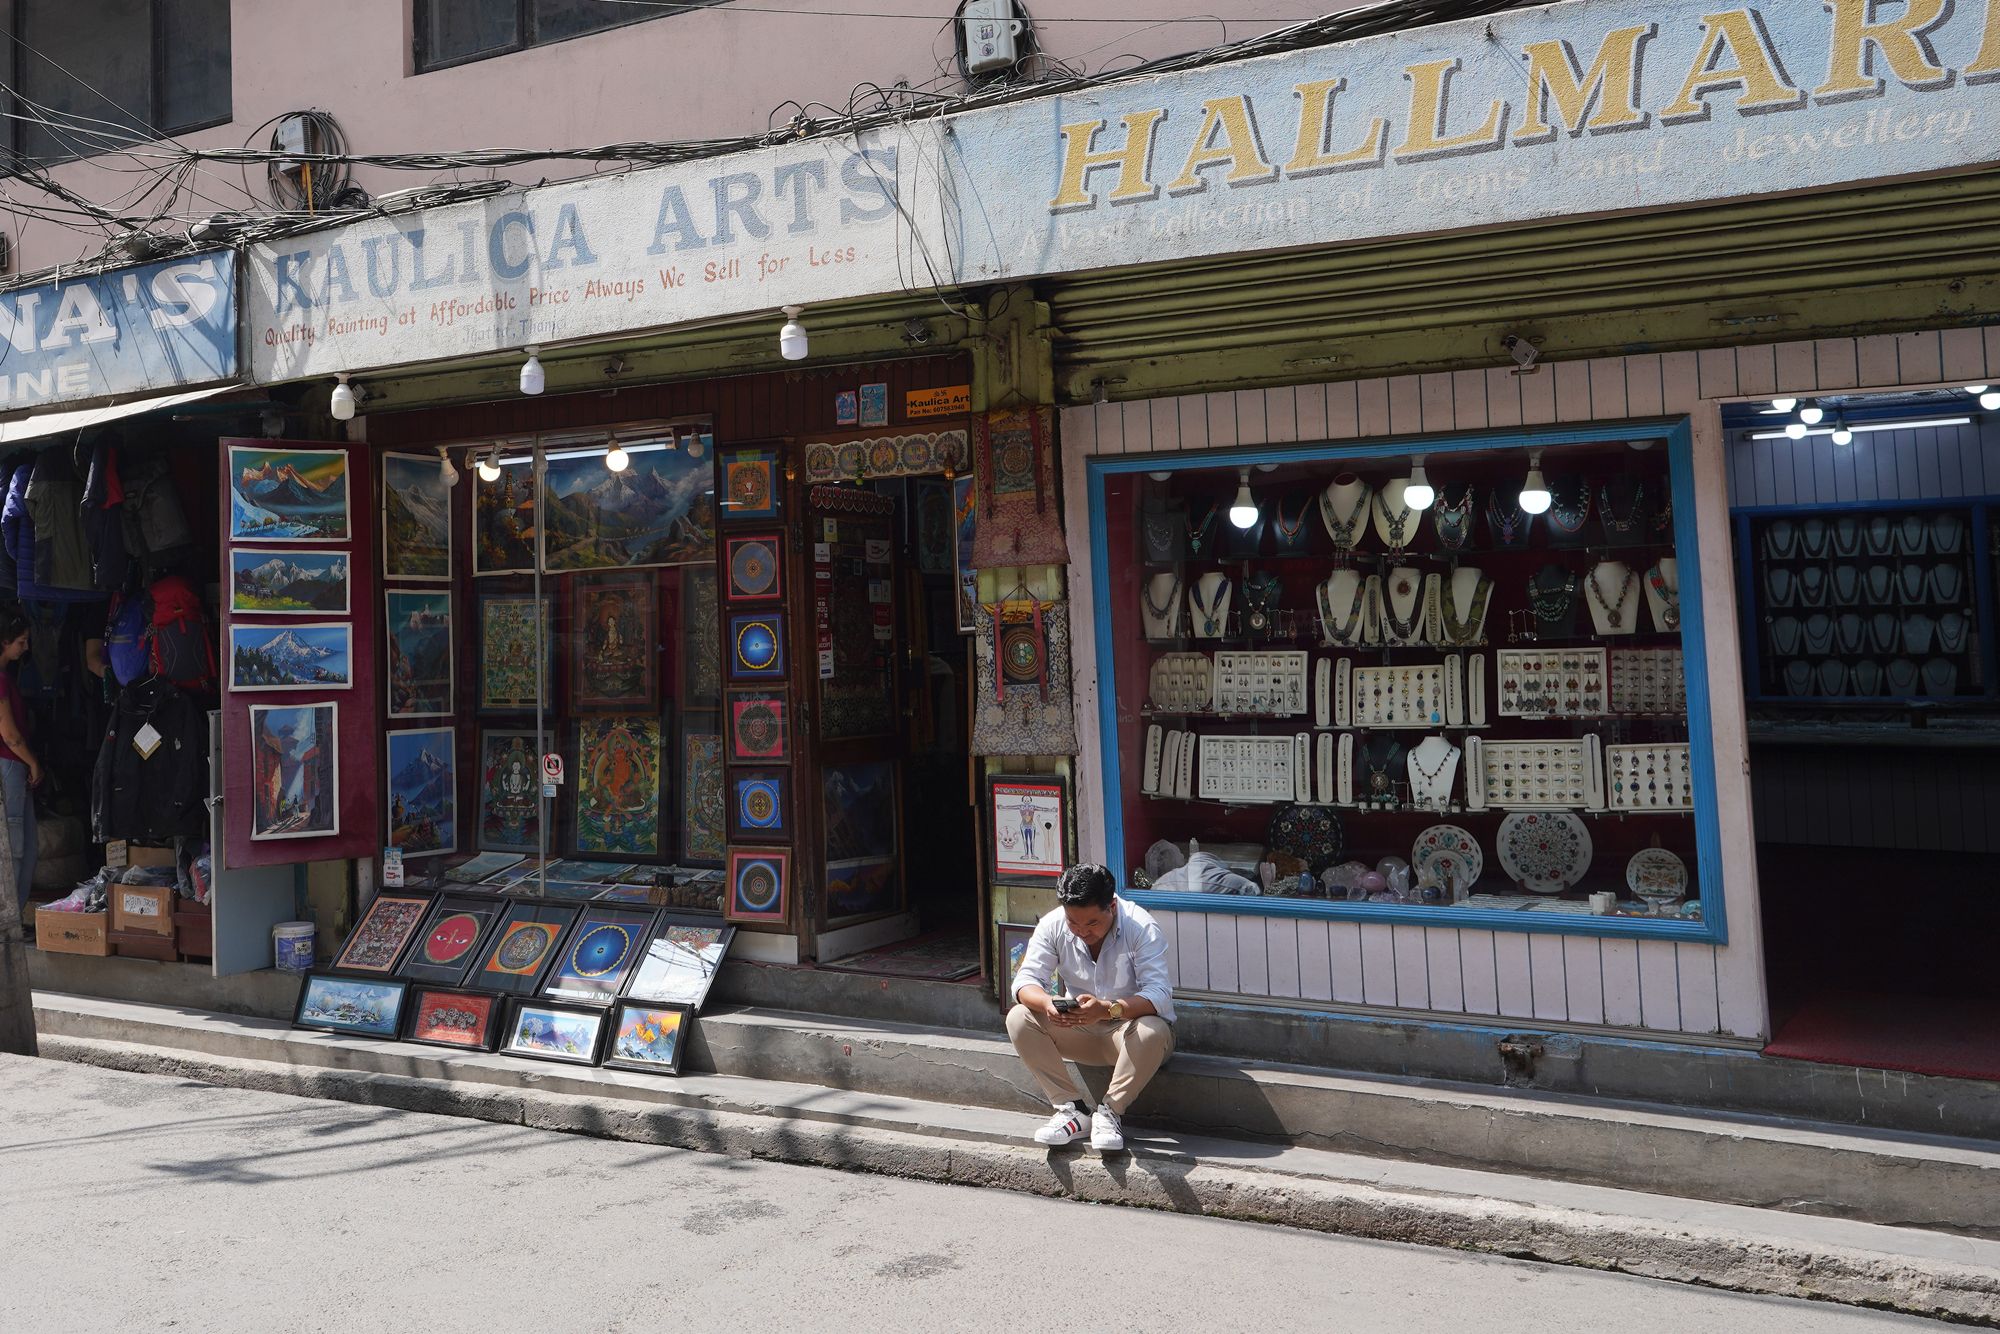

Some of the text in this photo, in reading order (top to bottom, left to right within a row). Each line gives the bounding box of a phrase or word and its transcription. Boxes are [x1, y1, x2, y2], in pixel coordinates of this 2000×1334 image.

[274, 142, 898, 315] KAULICA ARTS
[1150, 197, 1310, 241] Collection
[1414, 164, 1530, 203] Gems
[1577, 136, 1663, 180] and
[1721, 107, 1974, 162] Jewellery
[264, 323, 316, 349] Quality
[328, 313, 389, 338] Painting
[398, 306, 417, 326] at
[430, 291, 517, 326] Affordable
[529, 285, 570, 305] Price
[584, 275, 645, 303] Always
[659, 267, 686, 291] We
[704, 259, 740, 284] Sell
[757, 252, 789, 283] for
